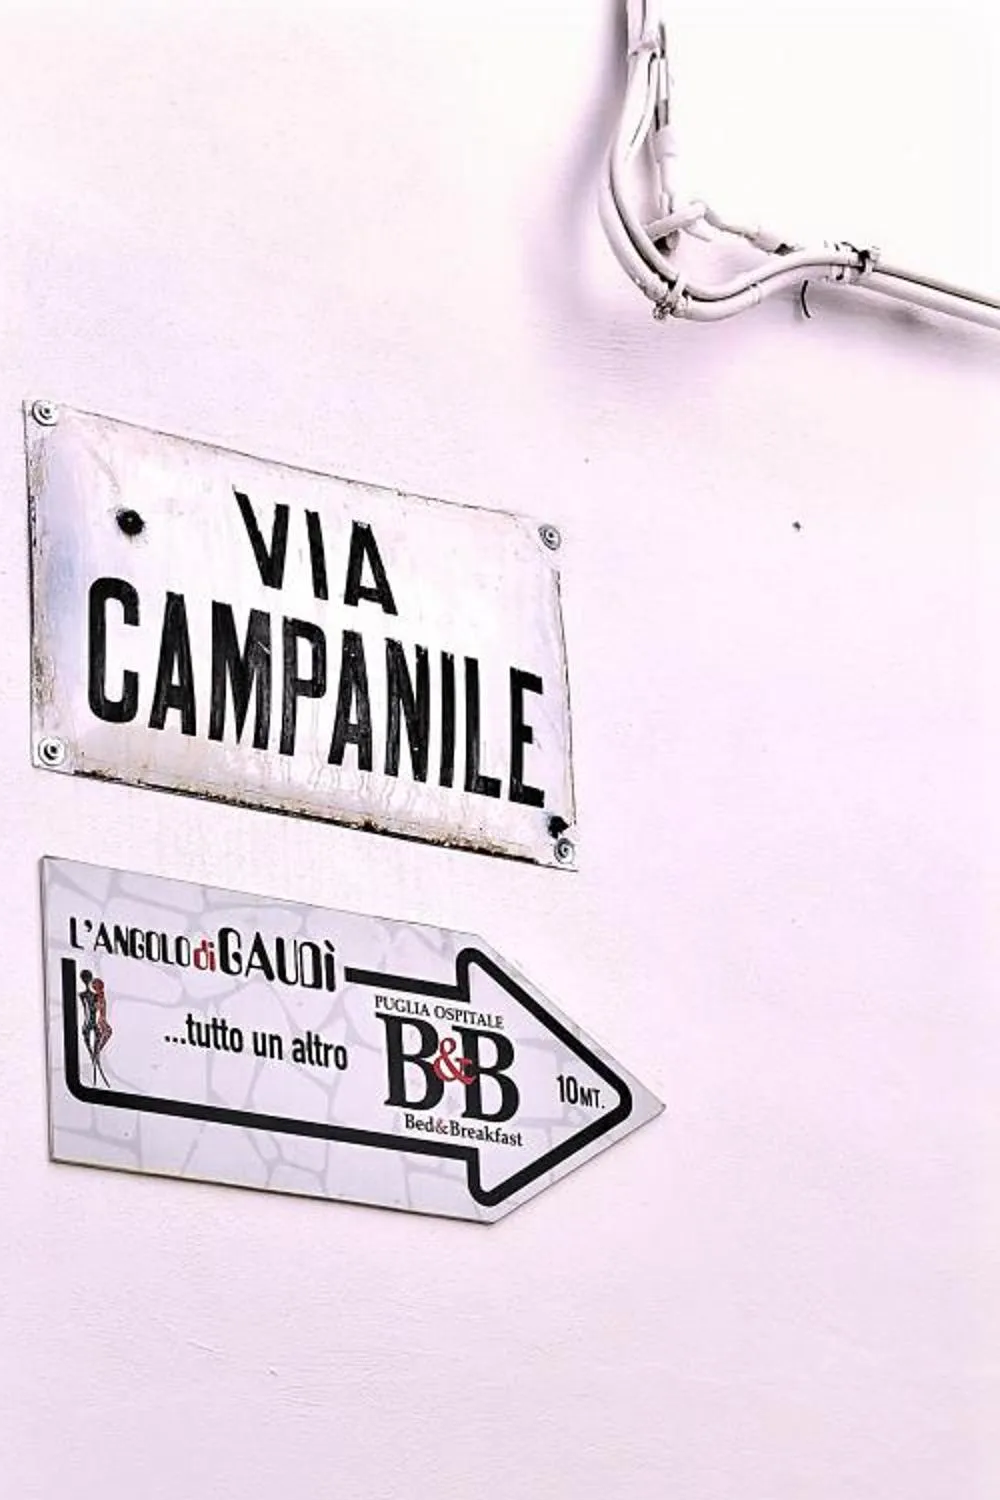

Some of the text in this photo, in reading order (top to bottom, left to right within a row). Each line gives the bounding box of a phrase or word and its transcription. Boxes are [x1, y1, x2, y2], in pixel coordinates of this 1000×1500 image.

[232, 487, 398, 616] VIA
[88, 577, 544, 808] CAMPANILE
[69, 916, 191, 967] L'ANGOLO
[193, 939, 216, 972] di
[375, 995, 504, 1029] PUGLIA OSPITALE
[253, 1031, 283, 1061] un
[292, 1031, 349, 1071] altro
[376, 1012, 520, 1123] B&B
[404, 1113, 523, 1147] Bed&Breakfast
